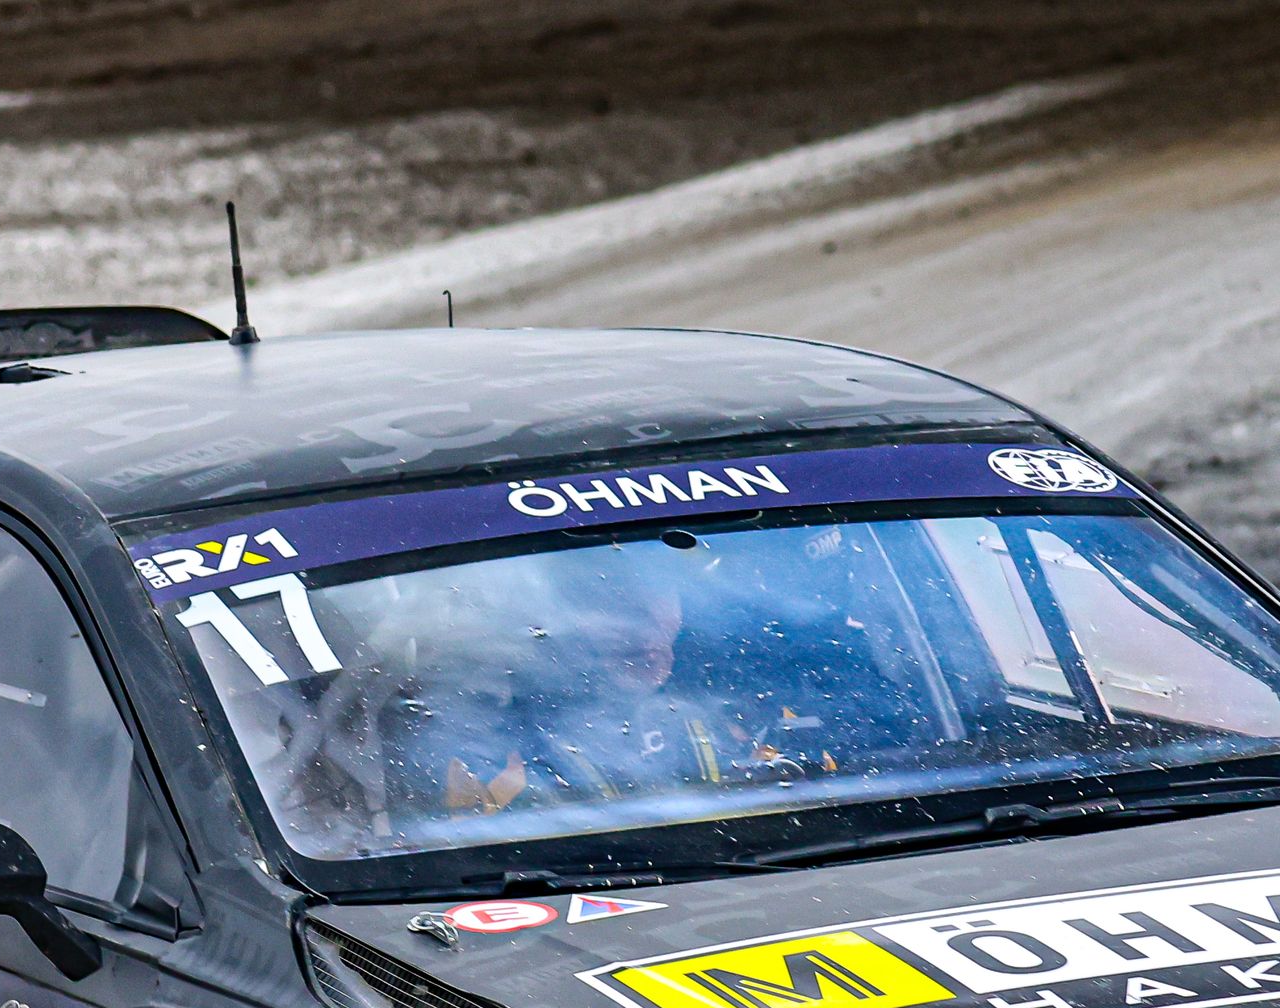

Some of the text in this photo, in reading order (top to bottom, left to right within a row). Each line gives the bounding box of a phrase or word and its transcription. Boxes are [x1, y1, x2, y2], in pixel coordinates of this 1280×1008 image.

[508, 464, 791, 518] ÖHMAN
[134, 528, 299, 590] EURO RX1
[175, 572, 343, 687] 17
